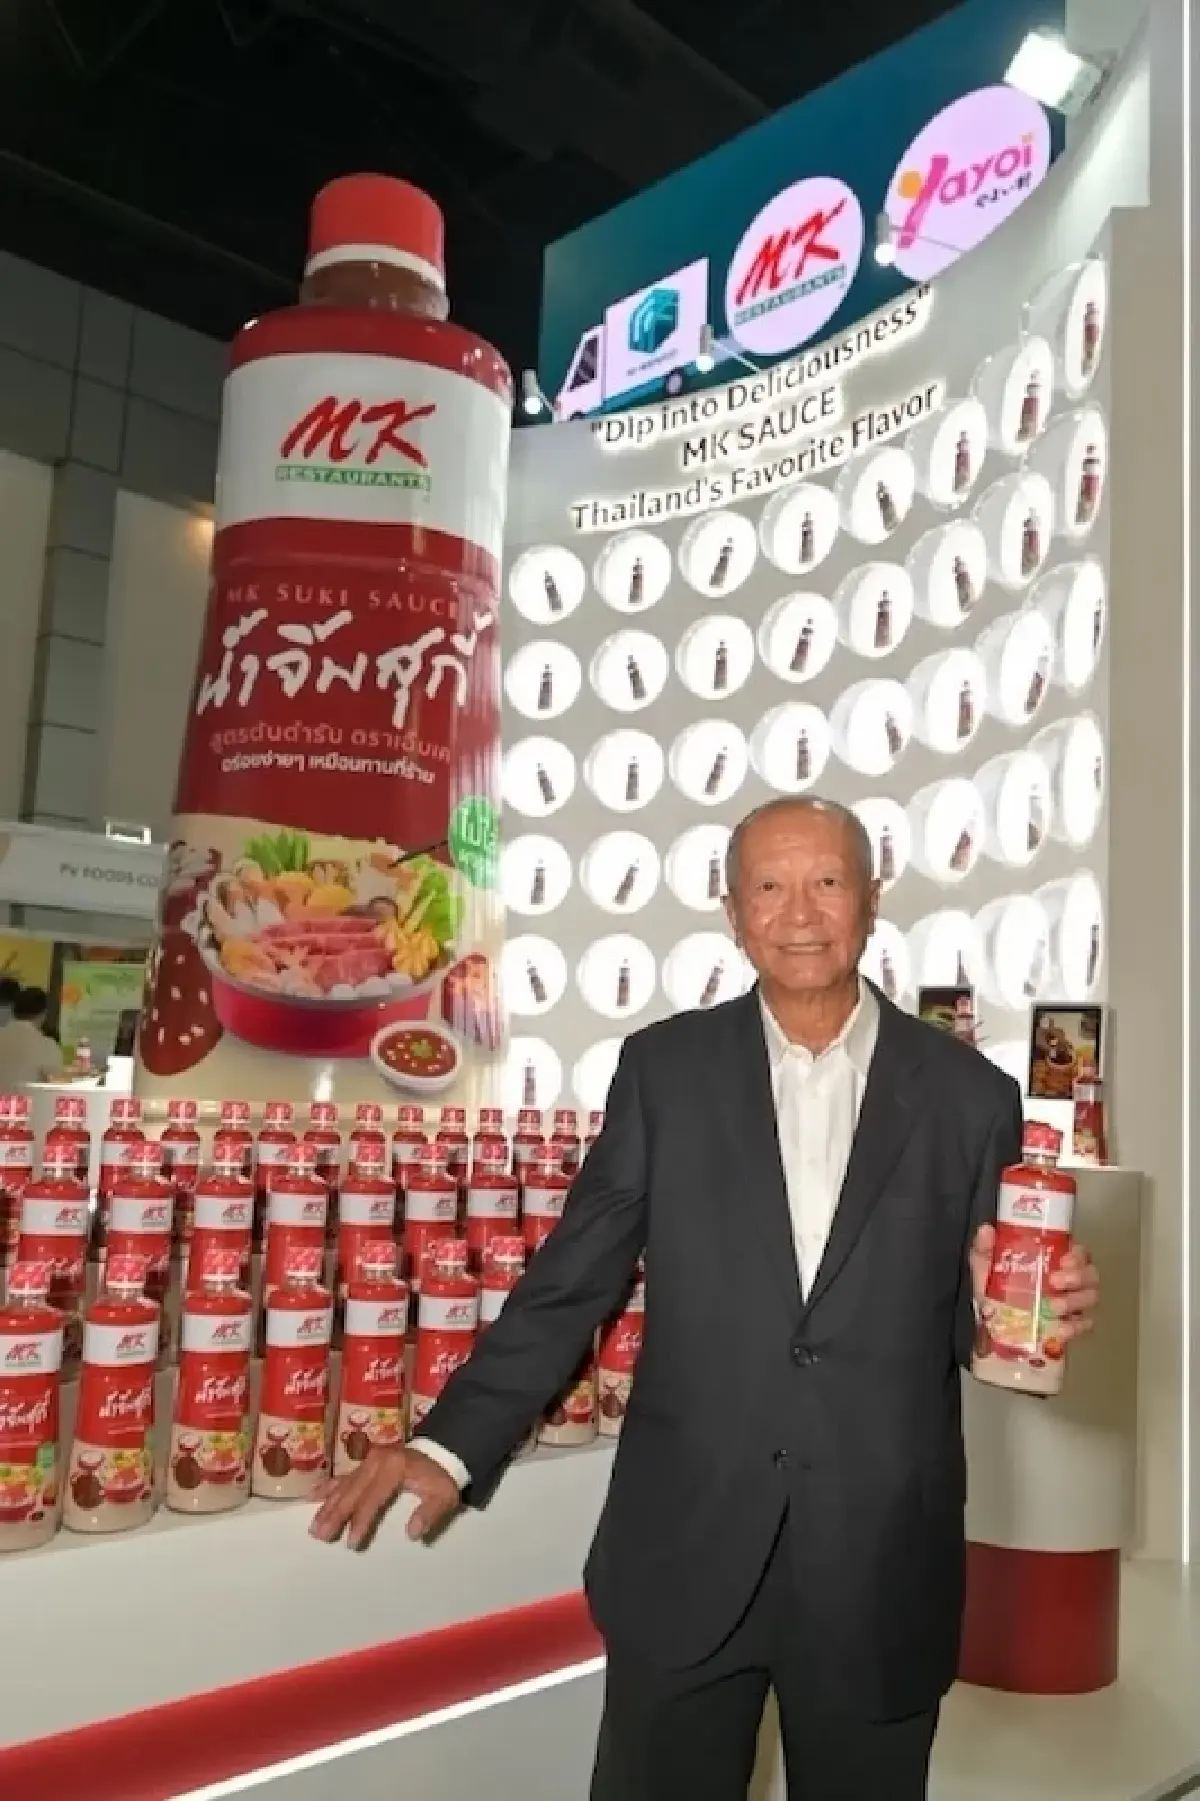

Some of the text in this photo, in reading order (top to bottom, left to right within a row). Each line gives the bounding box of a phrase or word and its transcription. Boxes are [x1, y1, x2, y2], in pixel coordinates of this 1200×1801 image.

[898, 132, 1034, 249] Yayoi
[734, 197, 849, 307] MK
[661, 397, 718, 431] into
[727, 281, 933, 411] Deliciousness"
[279, 395, 437, 468] MK
[570, 384, 939, 529] Thailand's Favorite Flavor
[683, 385, 837, 467] MK SAUCE
[276, 583, 349, 606] SUKI
